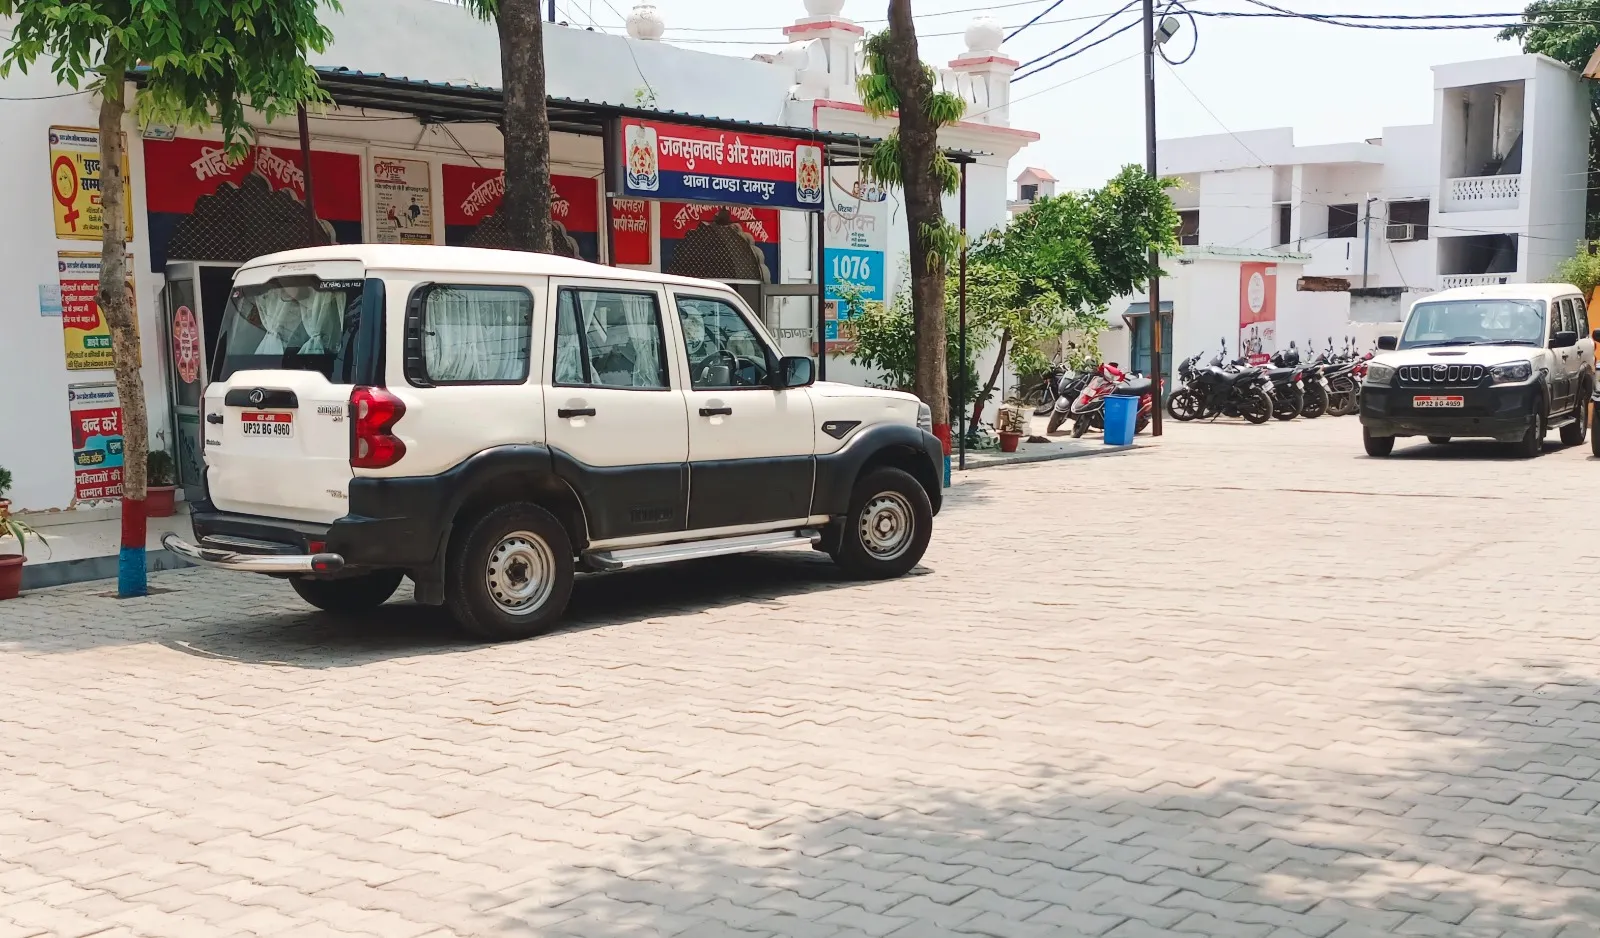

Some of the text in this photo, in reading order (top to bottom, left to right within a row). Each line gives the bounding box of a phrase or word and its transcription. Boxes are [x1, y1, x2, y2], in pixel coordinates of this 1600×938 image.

[659, 134, 794, 169] जनसुनवाई और समाधान
[461, 179, 498, 216] कार्यालय
[683, 174, 775, 200] थाना टाण्डा रामपुर
[832, 255, 870, 280] 1076
[81, 411, 117, 432] बन्द करें
[244, 423, 290, 435] UP32 BG 4960
[76, 470, 120, 484] महिलाओं की
[80, 487, 102, 498] सम्मान
